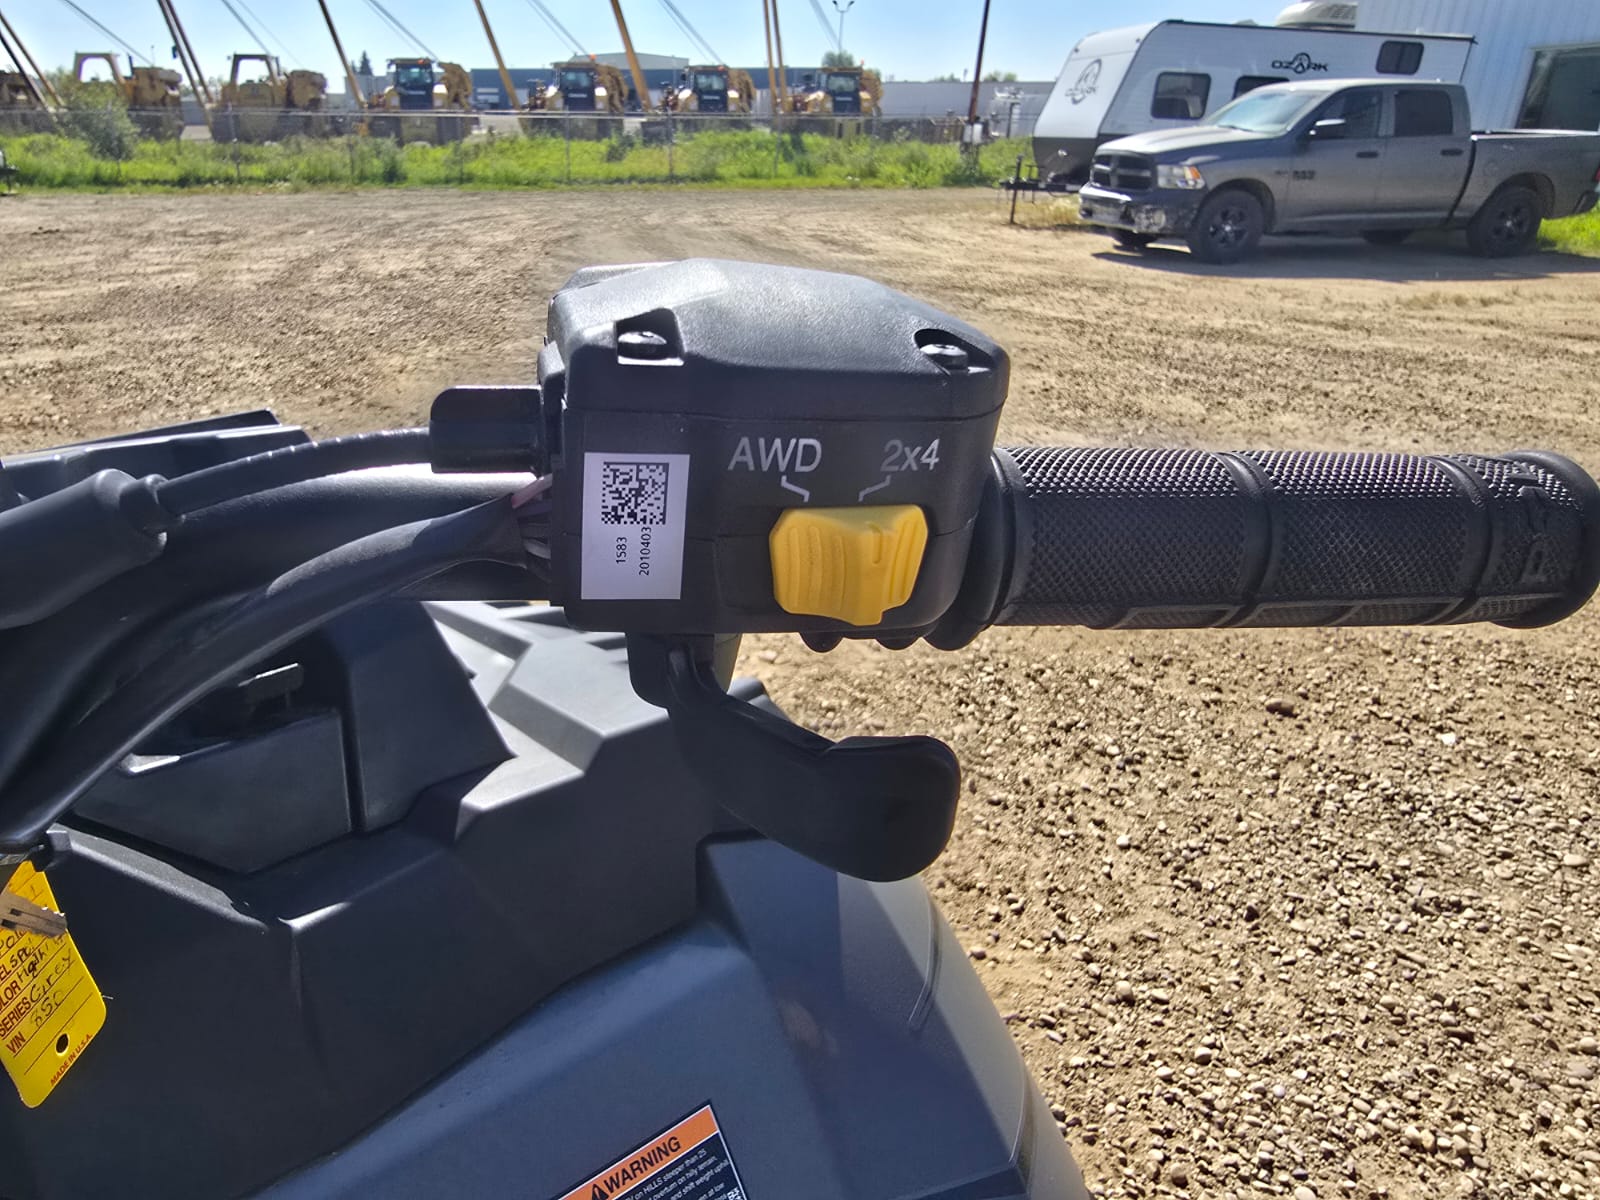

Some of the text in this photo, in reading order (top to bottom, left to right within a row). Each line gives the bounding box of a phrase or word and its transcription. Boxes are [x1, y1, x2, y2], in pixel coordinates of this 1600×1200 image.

[1271, 53, 1328, 74] OZARK
[728, 437, 822, 473] AWD
[880, 438, 940, 472] 2x4
[615, 536, 628, 564] 1583
[638, 526, 652, 576] 2010403
[0, 980, 21, 1009] LOR
[0, 997, 32, 1038] SERIES
[6, 1031, 26, 1054] VIN
[50, 1061, 69, 1086] MADE
[68, 1053, 77, 1064] IN
[603, 1135, 681, 1194] WARNING
[643, 1177, 663, 1194] HILLS
